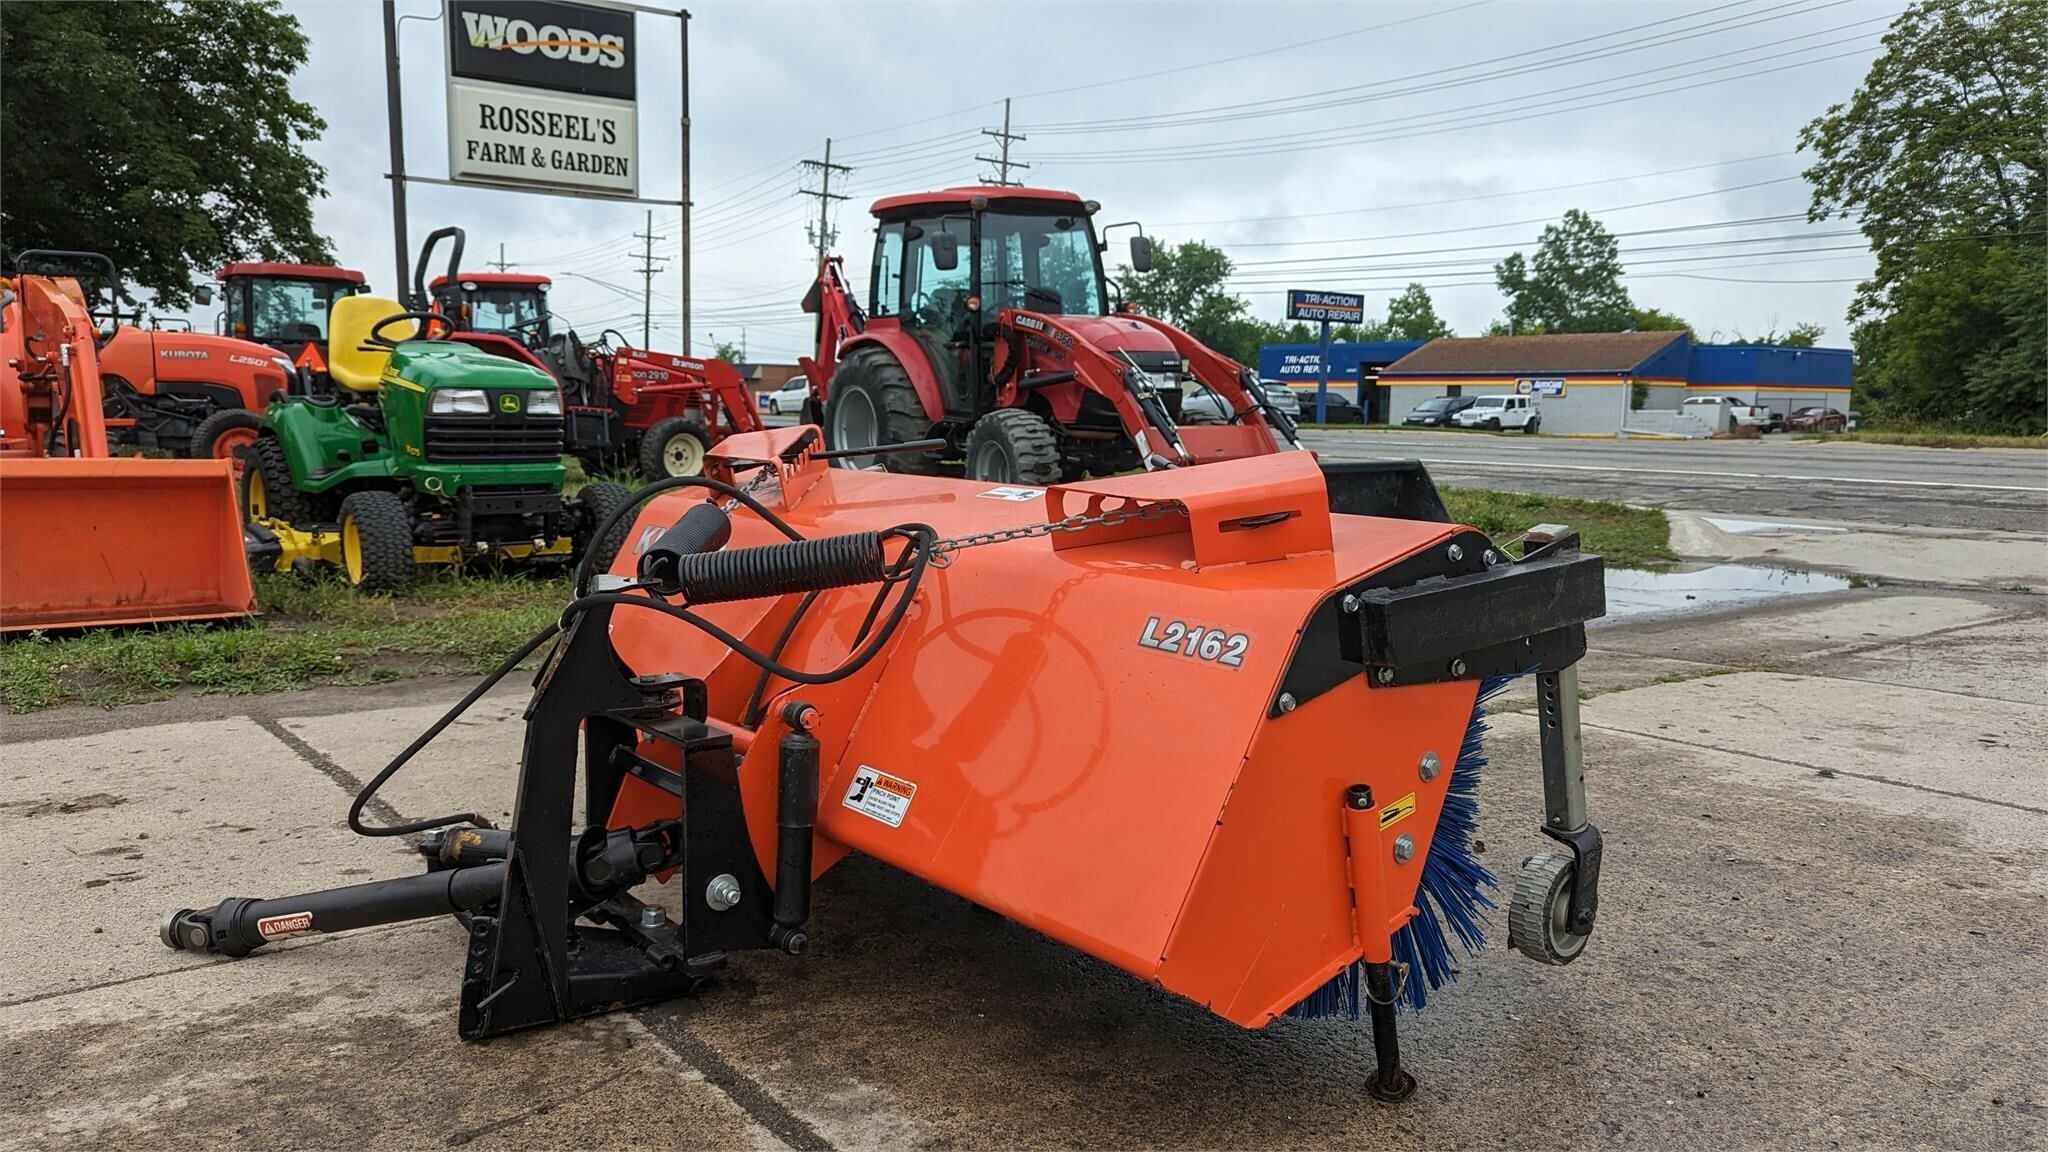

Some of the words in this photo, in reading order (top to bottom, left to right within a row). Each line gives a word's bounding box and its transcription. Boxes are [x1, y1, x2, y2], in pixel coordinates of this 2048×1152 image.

[462, 11, 625, 69] WOODS
[479, 103, 616, 145] ROSSEEL'S
[466, 140, 525, 166] FARM
[531, 147, 547, 168] &
[551, 149, 628, 177] GARDEN
[1304, 293, 1357, 307] TRI-ACTION
[1297, 308, 1325, 319] AUTO
[1327, 310, 1361, 321] REPAIR
[160, 350, 208, 359] KUBOTA
[229, 354, 268, 367] L2501
[1285, 355, 1320, 364] TRI-ACTI
[672, 357, 704, 370] Branson
[1280, 365, 1301, 374] AUTO
[1303, 365, 1331, 374] REPR
[1138, 616, 1249, 667] L2162
[884, 778, 912, 796] WARNING
[873, 788, 886, 798] PINCH
[887, 793, 901, 803] POINT
[273, 917, 310, 932] DANGER
